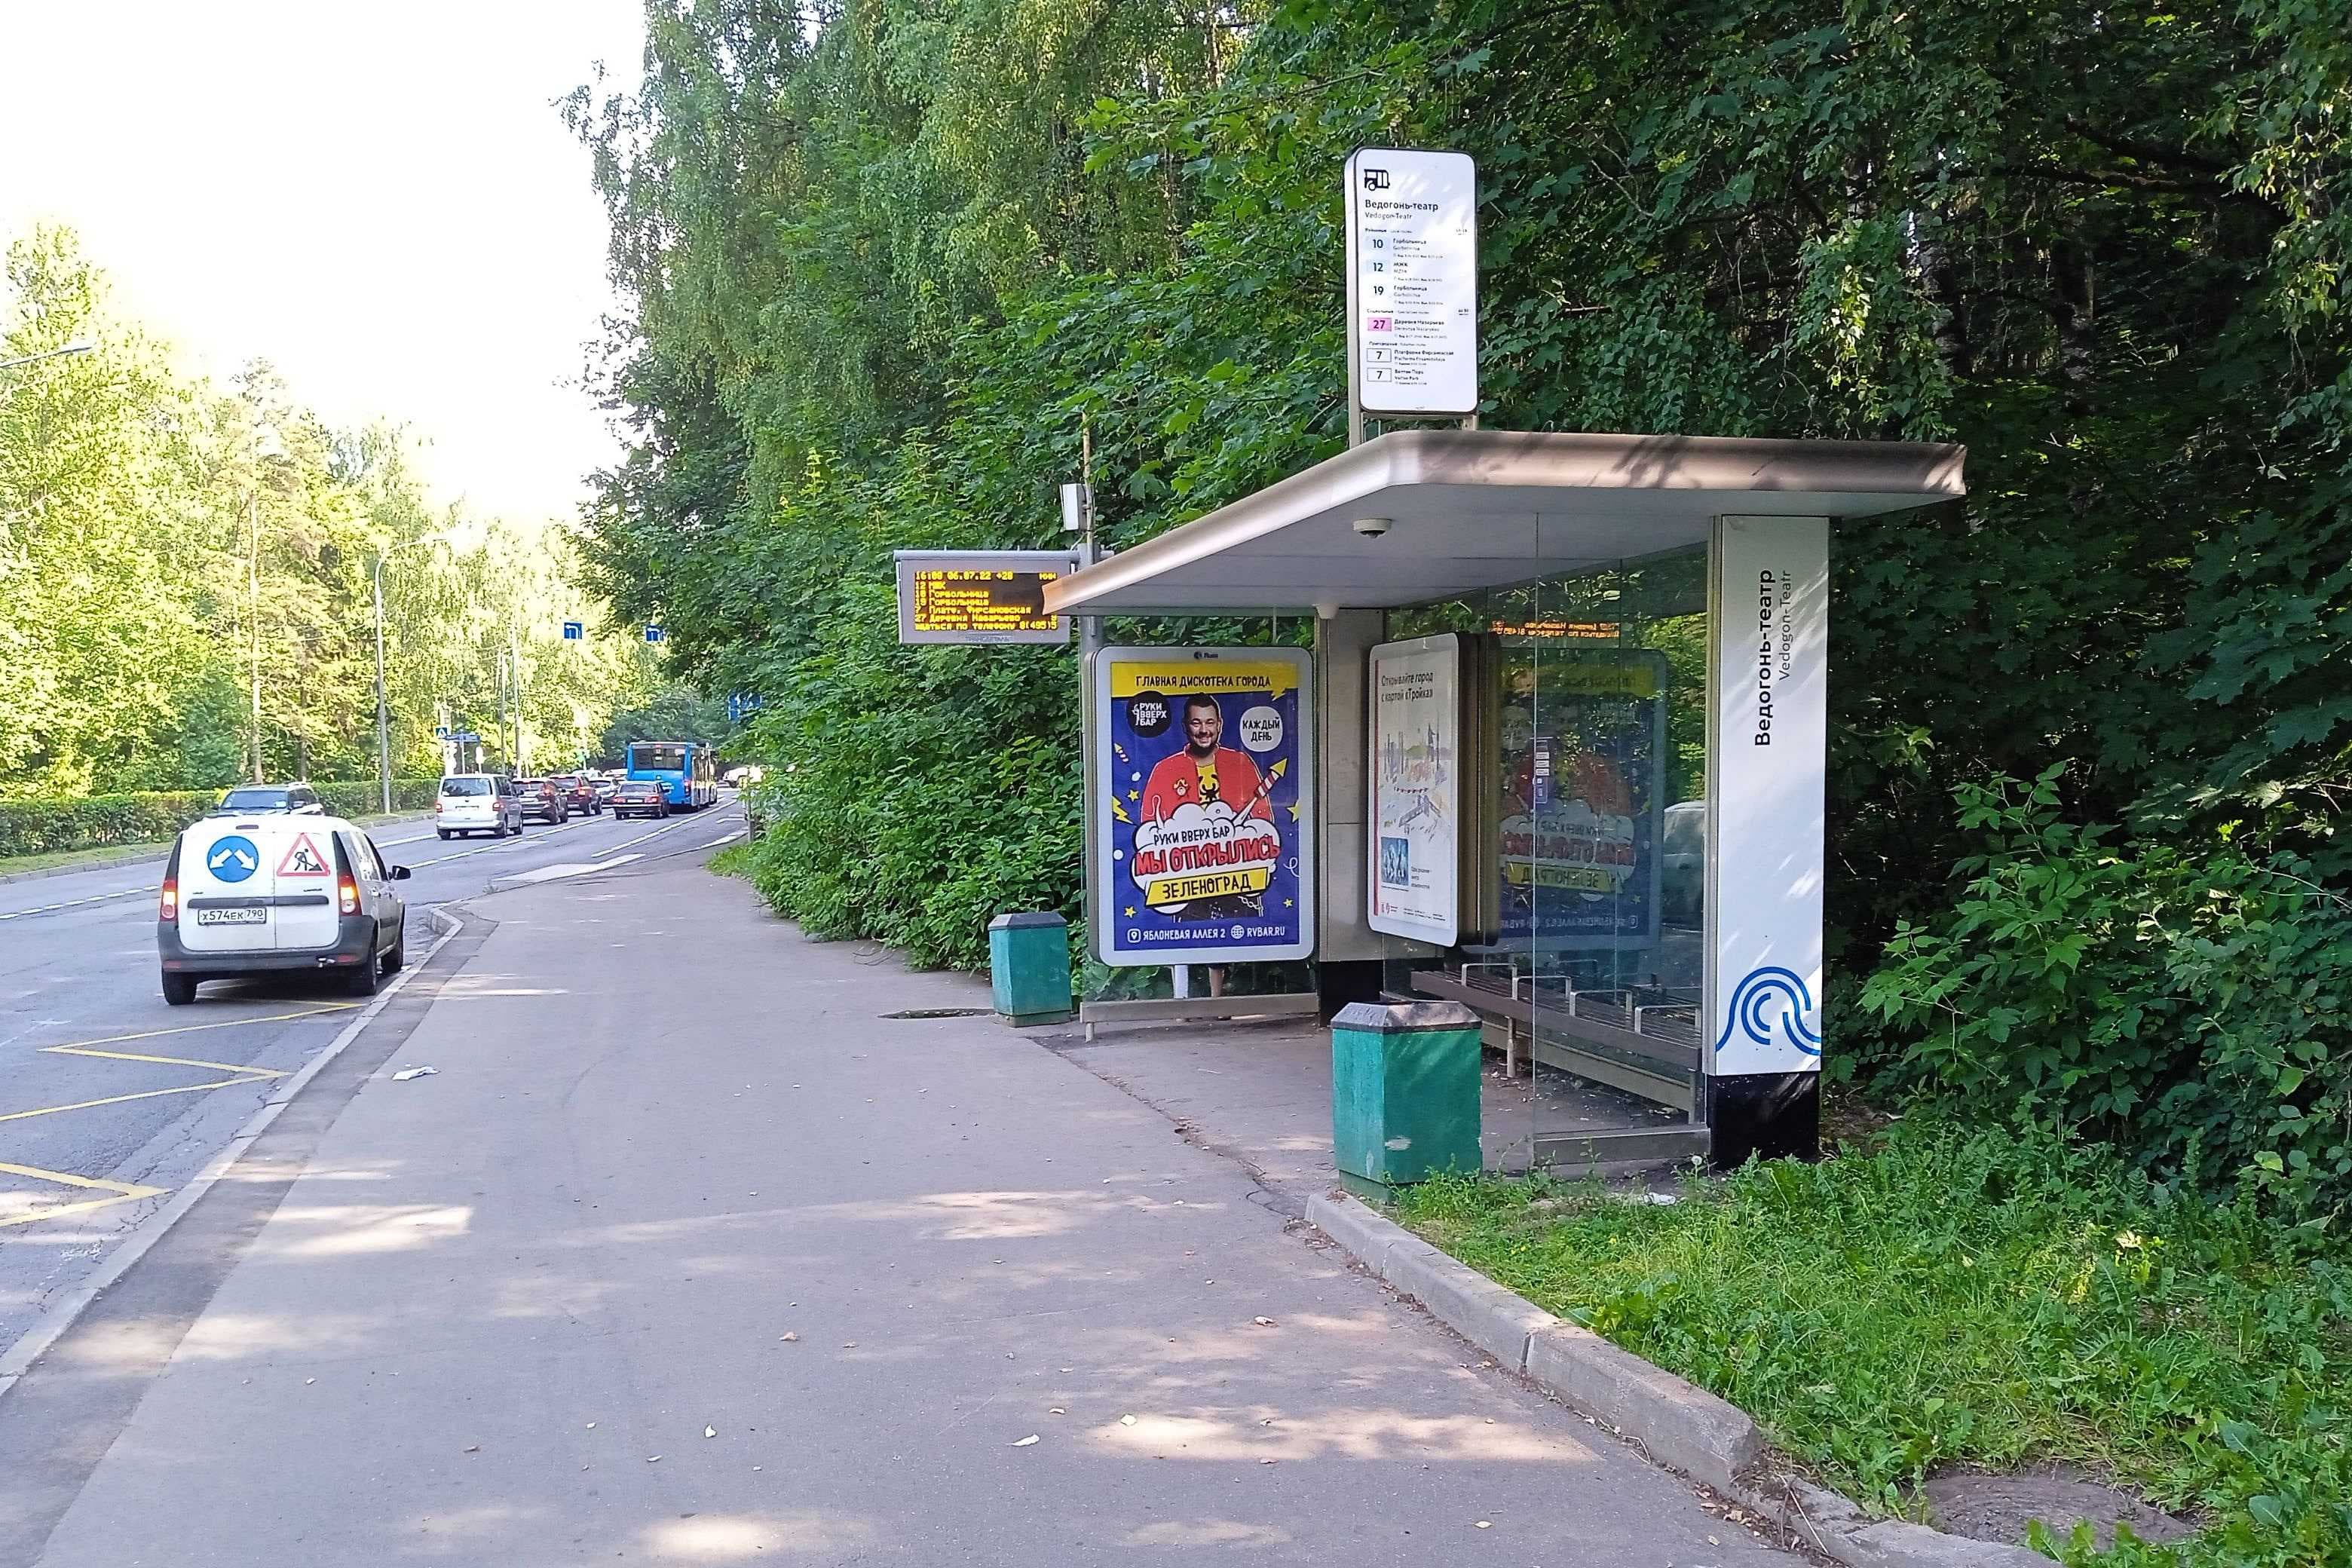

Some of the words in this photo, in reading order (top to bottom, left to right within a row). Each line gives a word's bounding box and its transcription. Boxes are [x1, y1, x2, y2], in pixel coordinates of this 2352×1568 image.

[1364, 199, 1438, 212] Ведогонь-театр
[1364, 212, 1412, 220] Vedogon-Teatr
[1373, 239, 1384, 249] 10
[1373, 262, 1384, 272] 12
[1374, 286, 1384, 296] 19
[1373, 320, 1386, 329] 27
[1376, 351, 1383, 360] 7
[1376, 370, 1383, 379] 7
[947, 571, 992, 580] 06.07.22
[915, 581, 926, 590] 12
[914, 606, 922, 614] 7
[914, 614, 927, 623] 27
[1779, 570, 1793, 681] Vedogon-Teatr
[1754, 569, 1775, 746] Ведогонь-театр
[1136, 675, 1177, 687] ГЛАВНАЯ
[1179, 675, 1233, 688] ДИСКОТЕКА
[1236, 675, 1271, 688] ГОРОДА
[1139, 703, 1162, 711] РУКИ
[1140, 710, 1167, 718] ВВЕРХ
[1139, 718, 1157, 726] БАР
[1242, 716, 1280, 730] КАЖДЫЙ
[1251, 731, 1272, 743] ДЕНЬ
[1153, 833, 1179, 846] РУКИ
[1181, 829, 1211, 843] ВВЕРХ
[1212, 825, 1230, 839] БАР
[1135, 849, 1168, 876] МЫ
[1169, 833, 1281, 872] ОТКРЫЛИСЬ
[1162, 873, 1252, 899] ЗЕЛЕНОГРАД
[1143, 929, 1190, 940] ЯБЛОНЕВАЯ
[1192, 928, 1218, 939] АЛЛЕЯ
[1220, 928, 1226, 939] 2
[1246, 926, 1285, 938] RVBAR.RU
